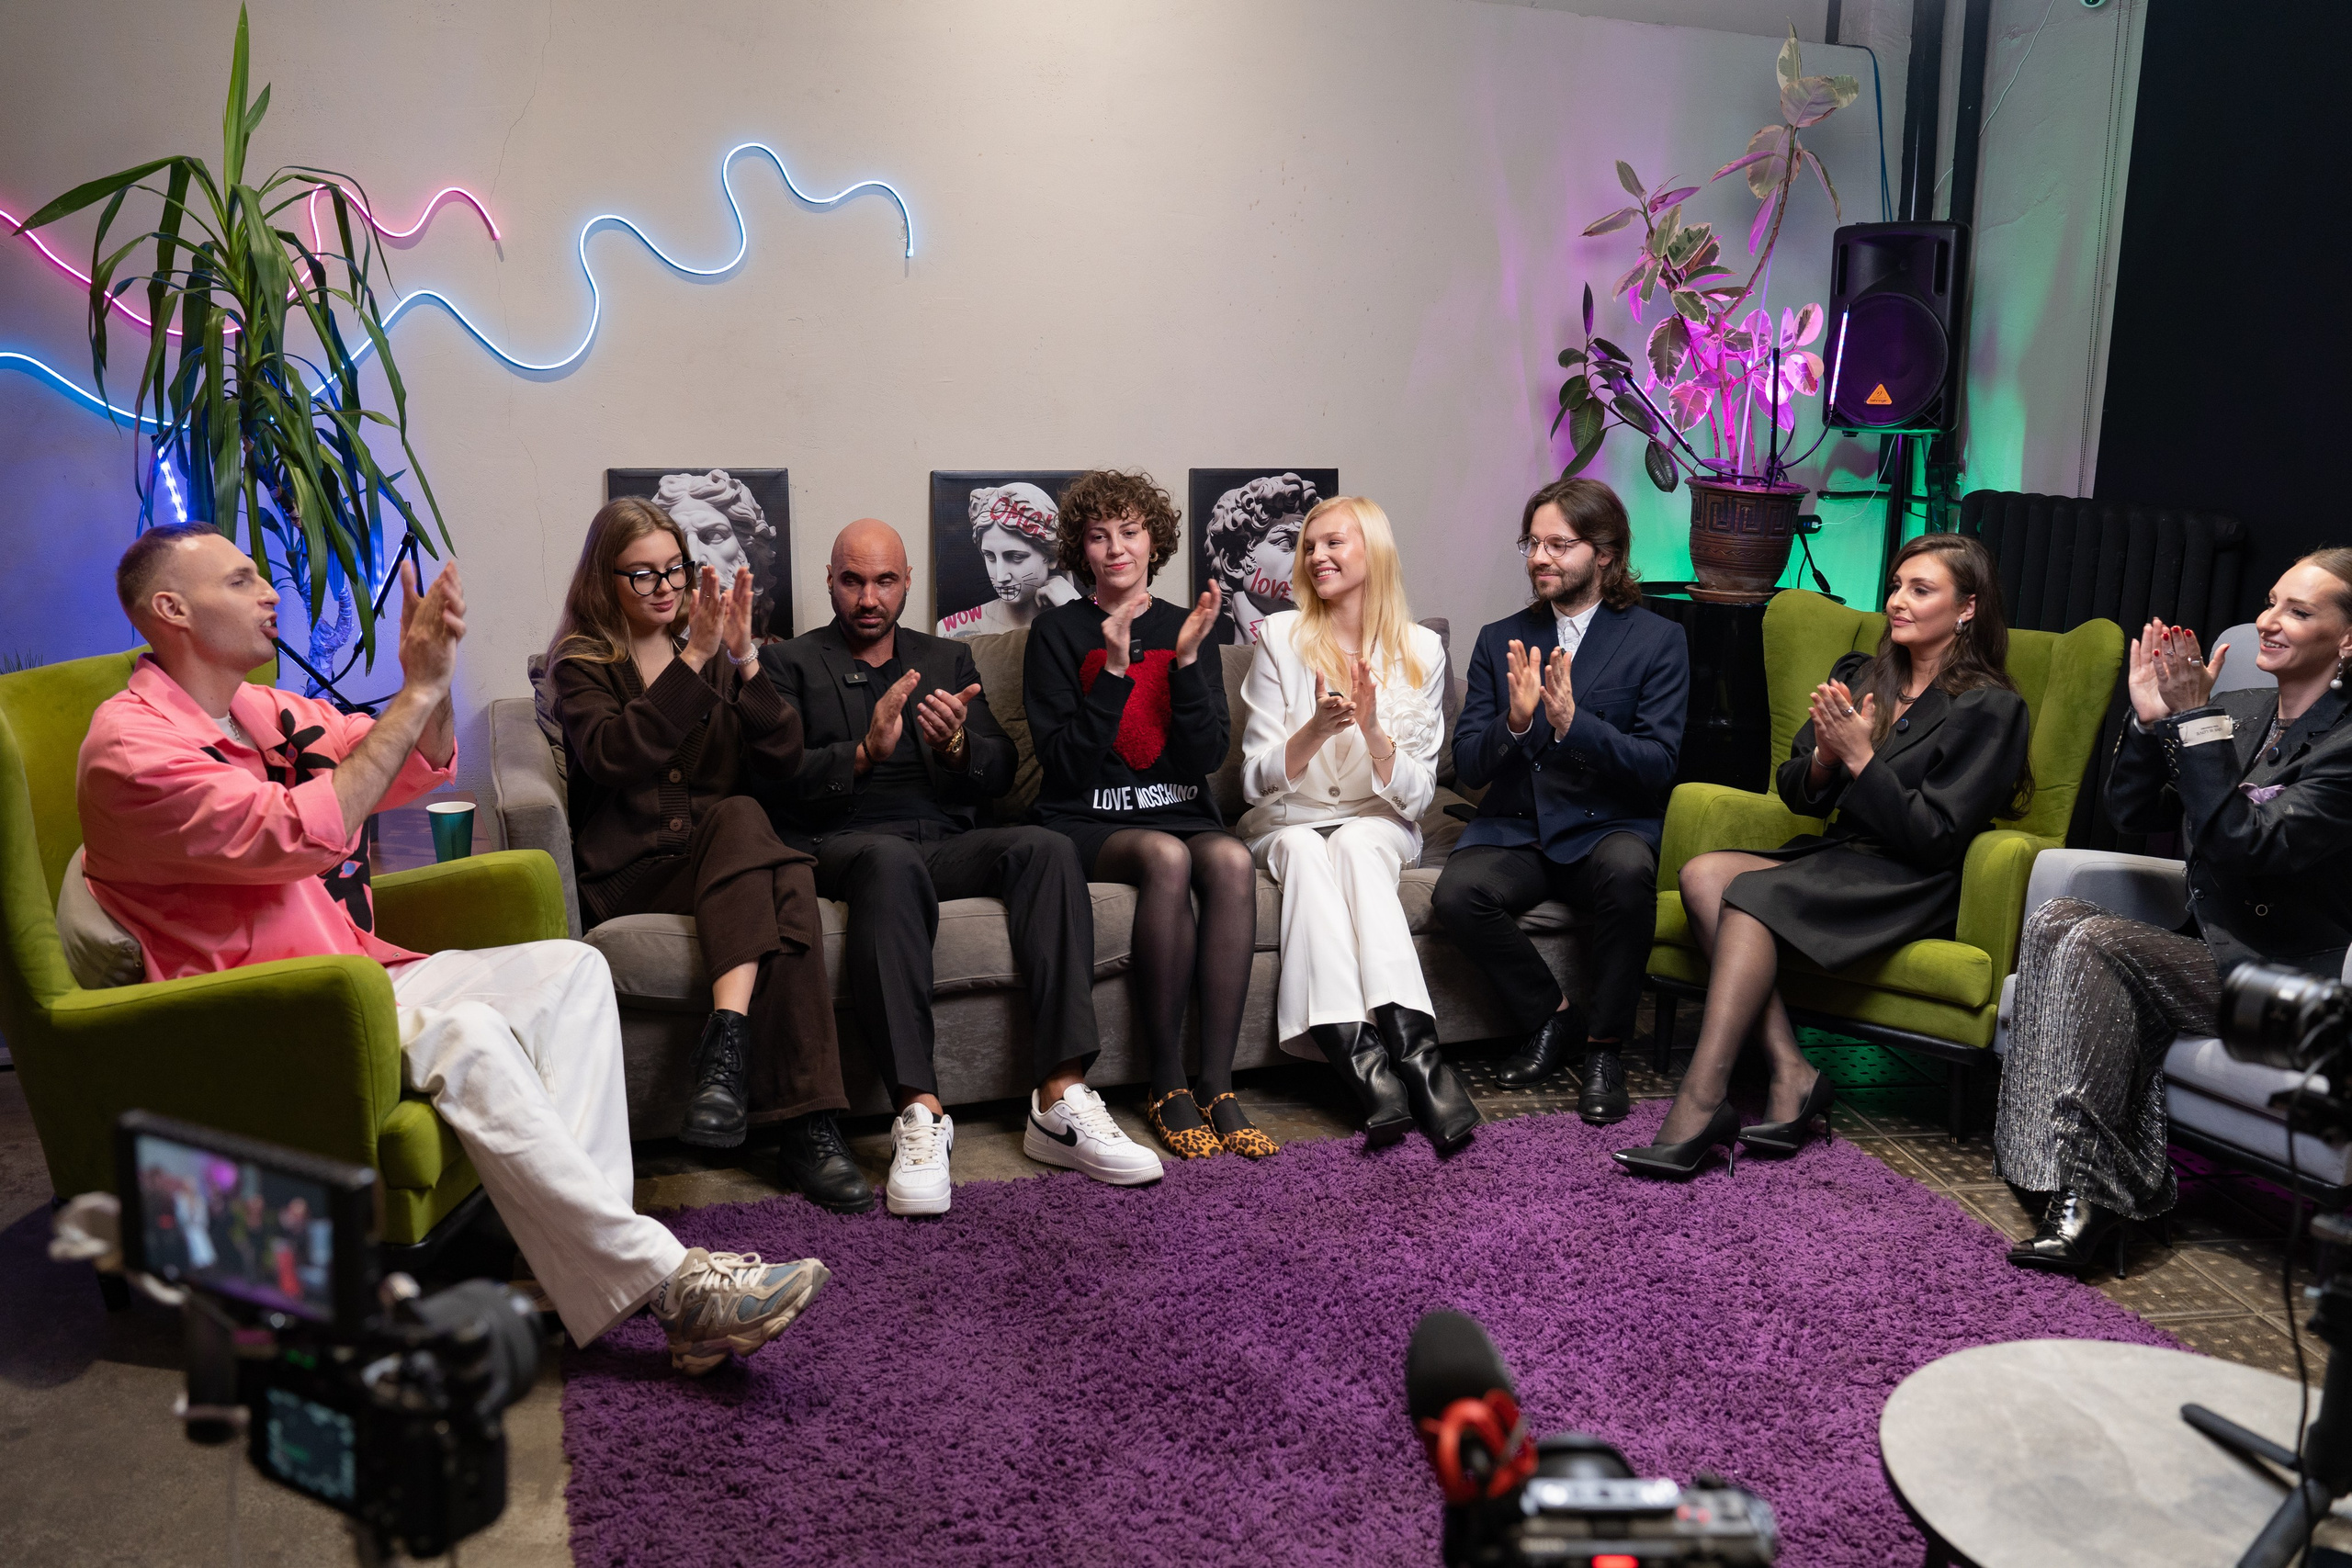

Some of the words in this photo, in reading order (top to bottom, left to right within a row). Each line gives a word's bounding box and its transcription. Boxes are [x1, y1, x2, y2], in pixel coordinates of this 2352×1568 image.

[942, 605, 982, 632] WOW
[1092, 786, 1134, 811] LOVE
[1135, 784, 1198, 809] MOSCHINO
